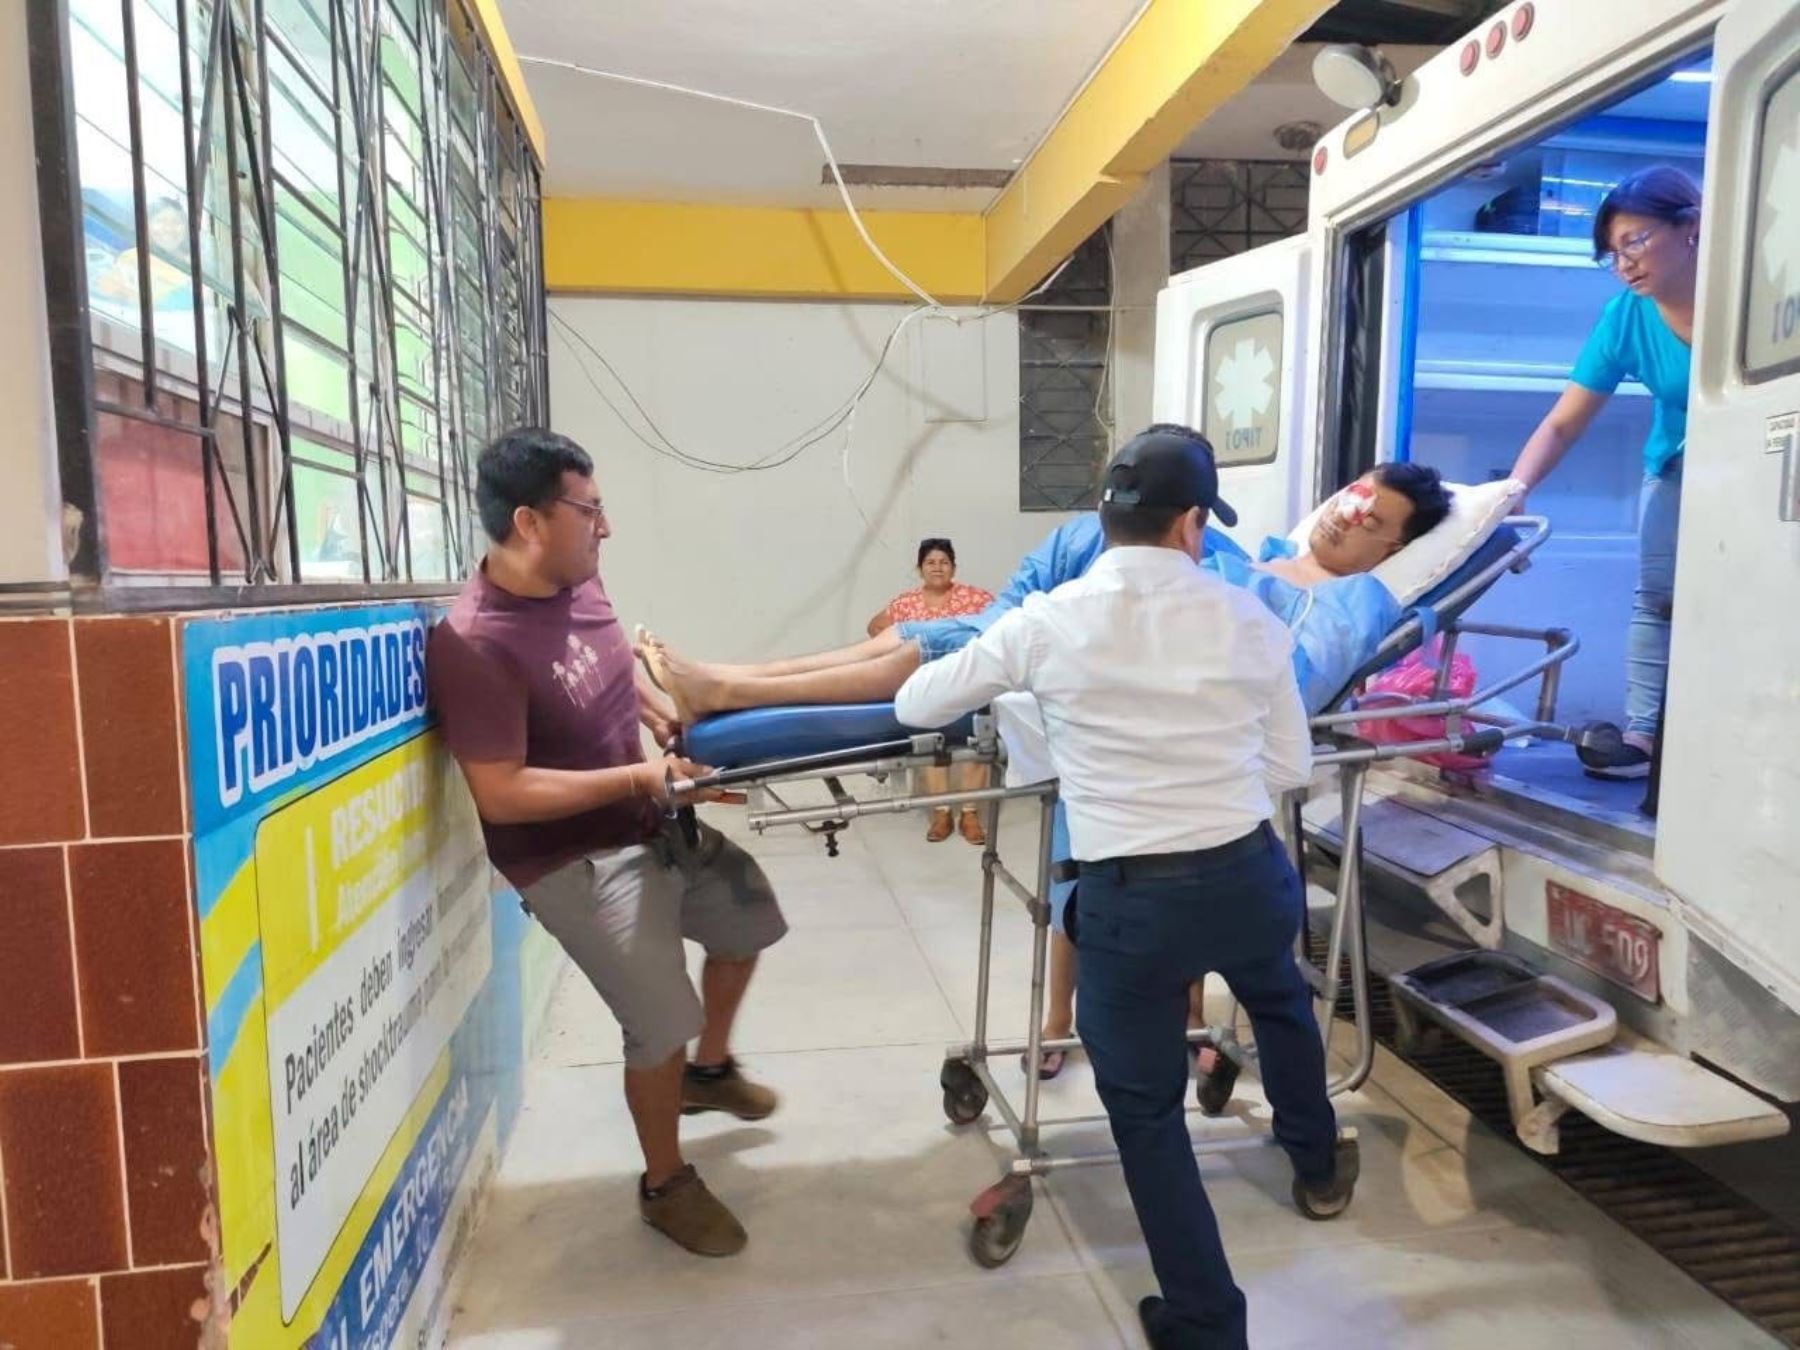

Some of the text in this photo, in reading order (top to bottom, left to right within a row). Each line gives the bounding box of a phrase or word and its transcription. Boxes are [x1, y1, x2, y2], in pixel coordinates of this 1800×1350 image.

[216, 625, 427, 794] PRIORIDADES
[285, 996, 354, 1115] Pacientes
[361, 950, 392, 1016] deben
[290, 1141, 304, 1210] al
[308, 1105, 338, 1182] área
[341, 1075, 356, 1131] de
